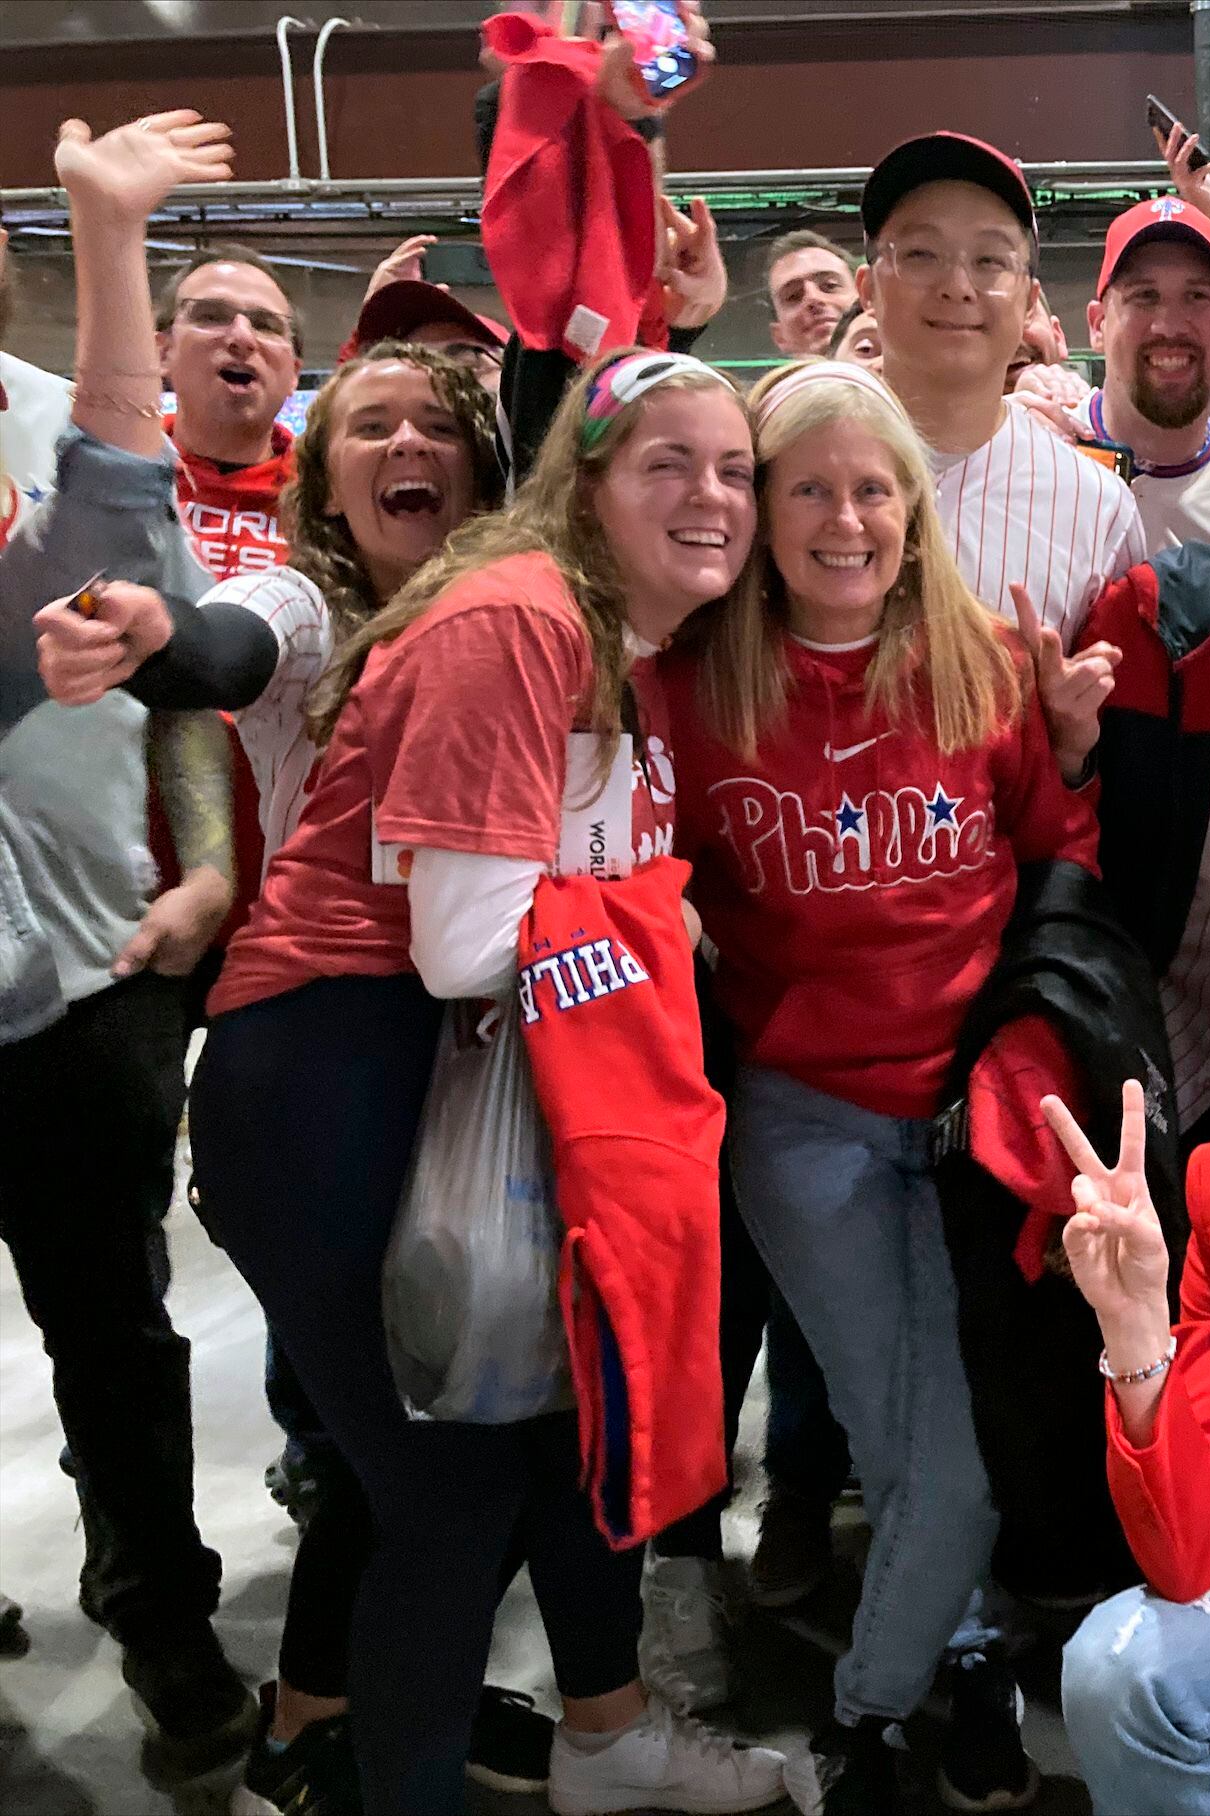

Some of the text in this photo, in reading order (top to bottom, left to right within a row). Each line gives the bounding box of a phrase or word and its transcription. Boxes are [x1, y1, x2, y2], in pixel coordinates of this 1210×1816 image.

[182, 501, 288, 545] ORL
[589, 819, 607, 882] WORL
[705, 776, 997, 896] Phillie
